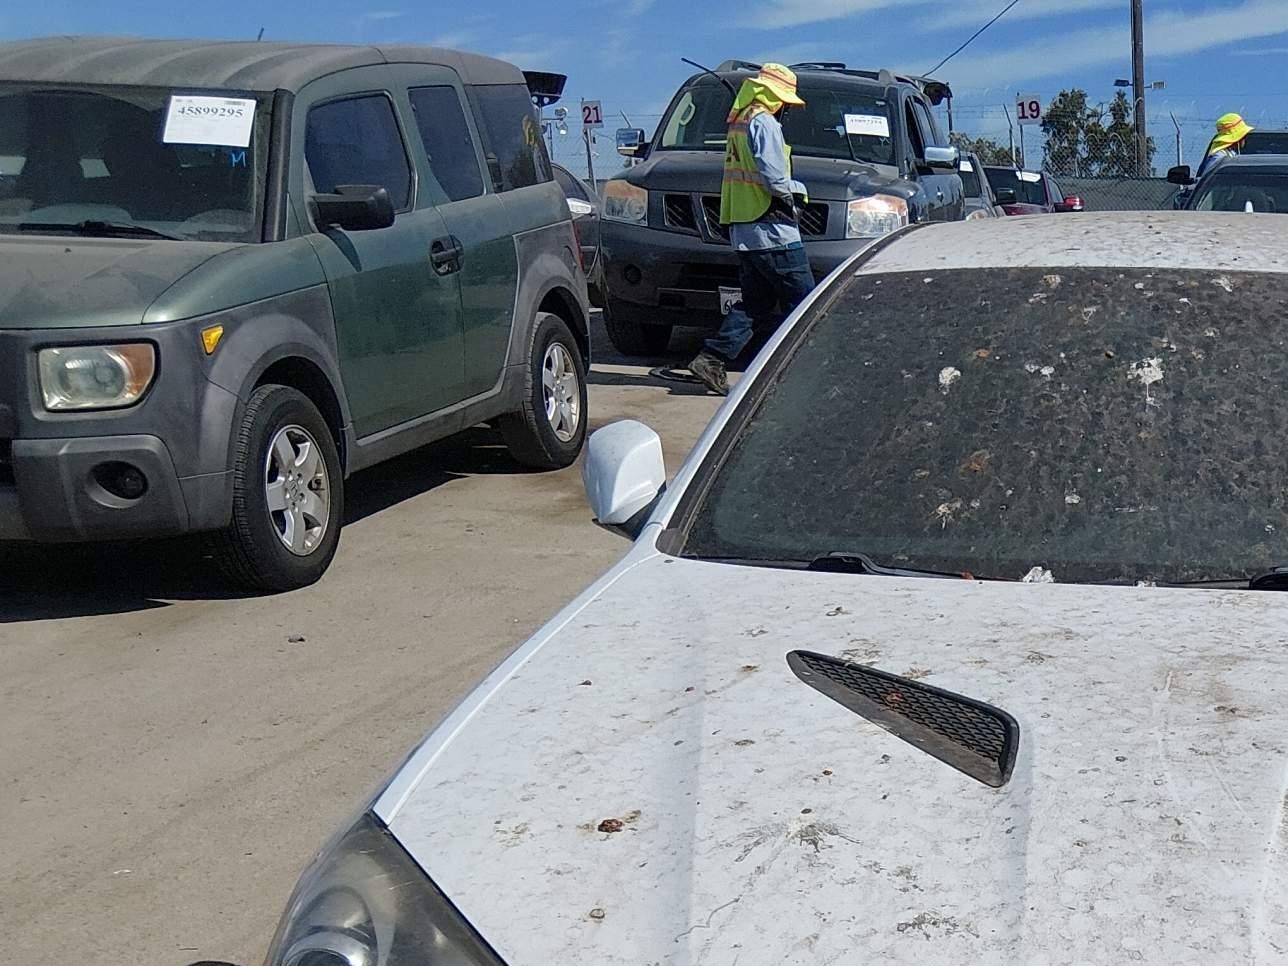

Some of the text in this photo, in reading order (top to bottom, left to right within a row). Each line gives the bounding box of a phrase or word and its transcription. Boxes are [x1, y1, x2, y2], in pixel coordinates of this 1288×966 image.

[178, 106, 244, 118] 45899295
[582, 105, 603, 124] 21
[1017, 100, 1041, 119] 19
